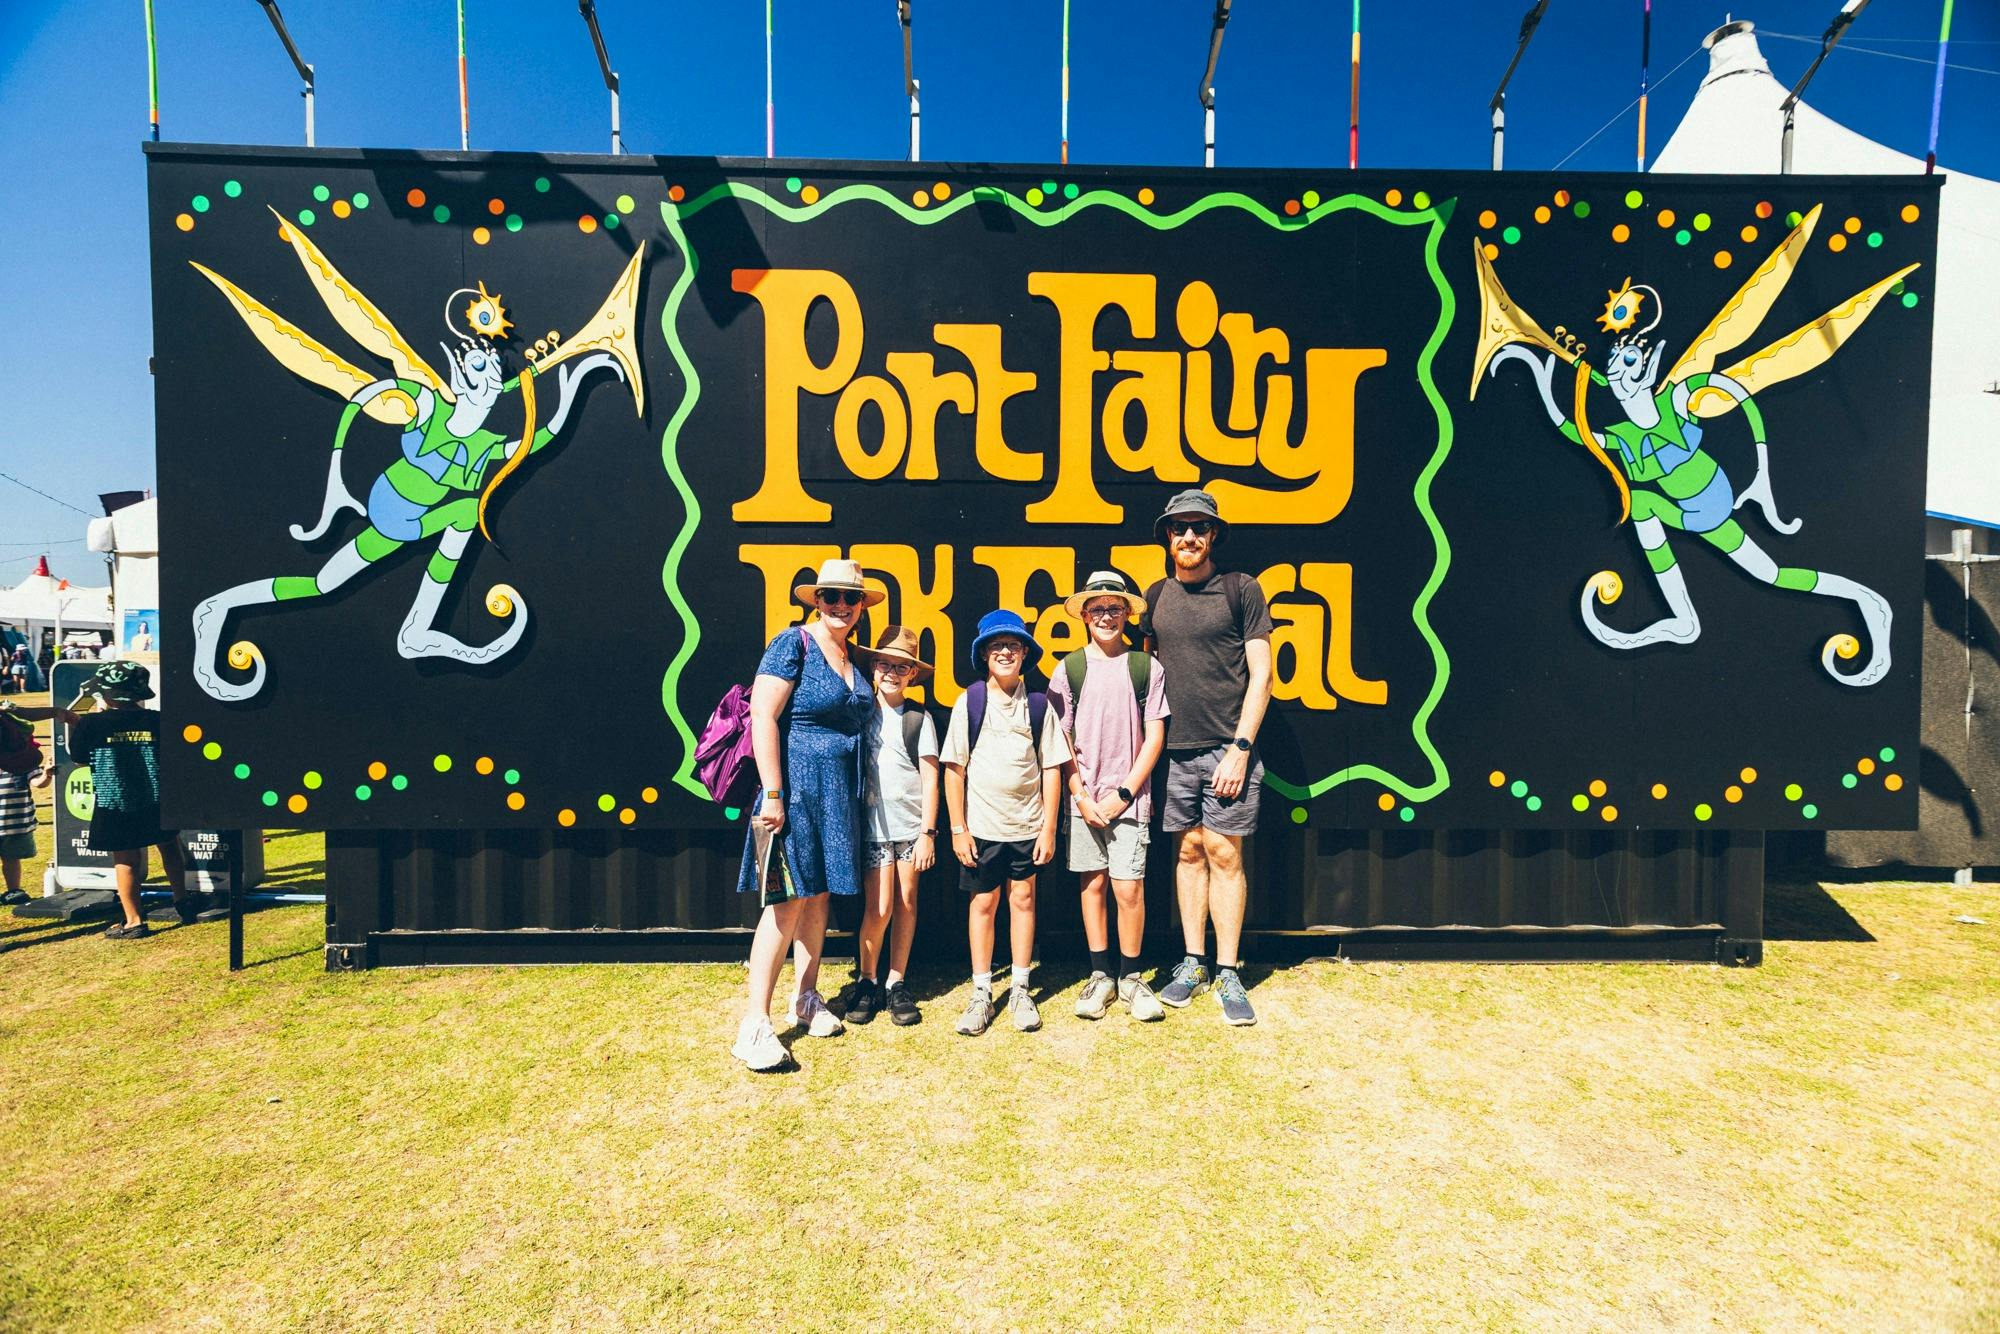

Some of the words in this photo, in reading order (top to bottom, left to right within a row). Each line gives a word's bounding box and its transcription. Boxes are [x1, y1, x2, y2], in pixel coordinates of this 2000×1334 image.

[731, 268, 1045, 524] Port
[1025, 272, 1388, 525] Fairy
[197, 833, 220, 843] FREE
[193, 851, 225, 861] WATER
